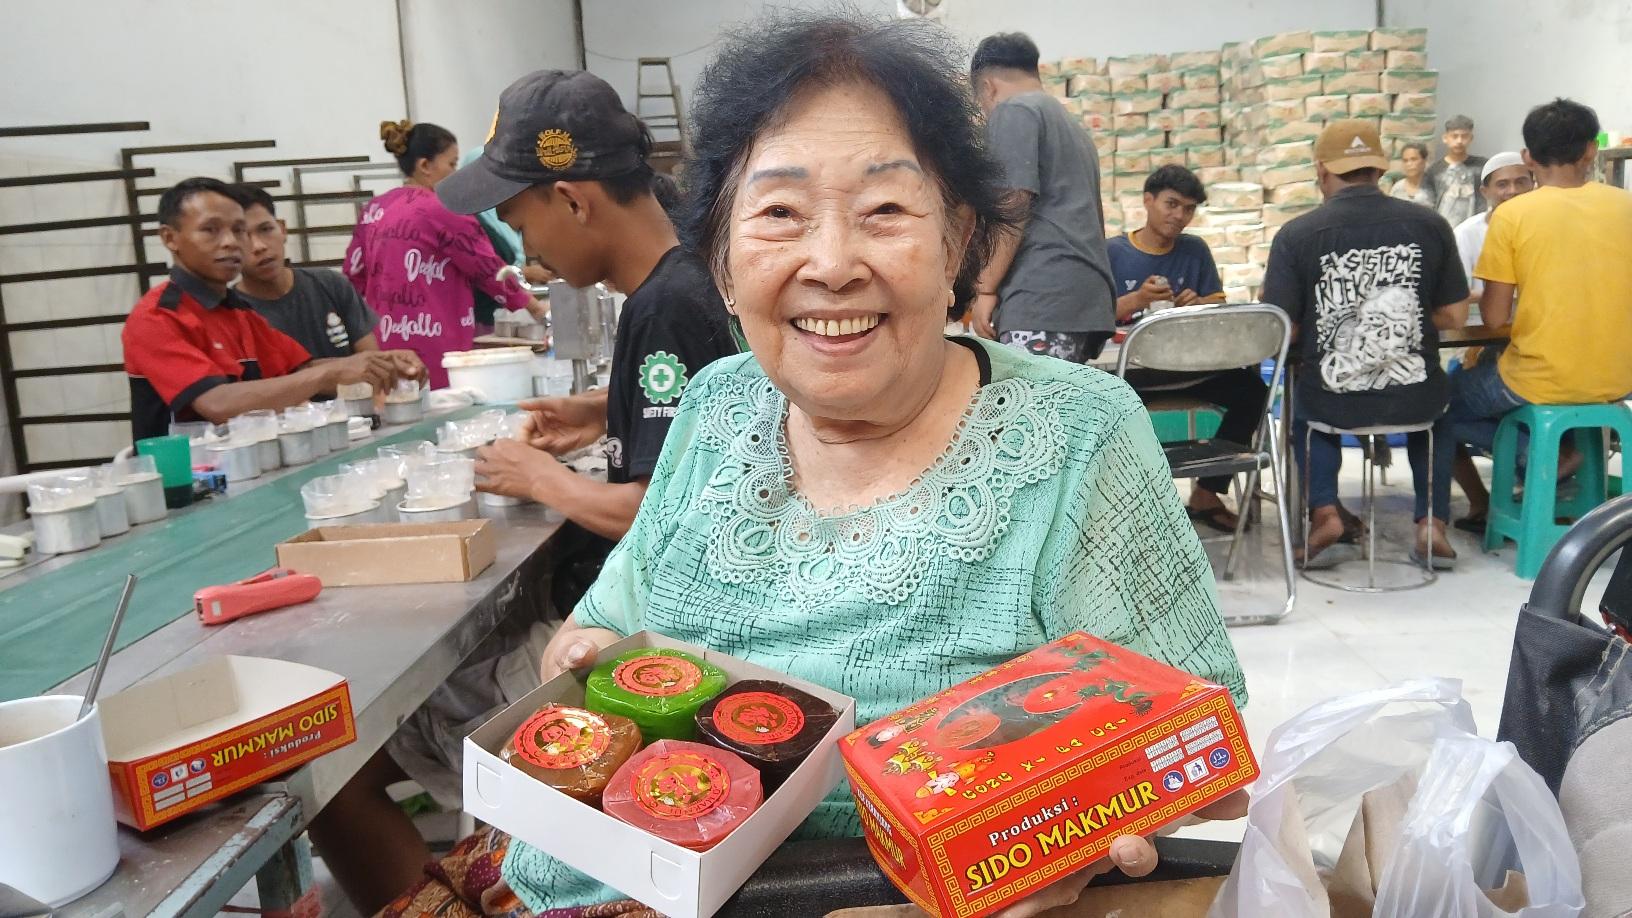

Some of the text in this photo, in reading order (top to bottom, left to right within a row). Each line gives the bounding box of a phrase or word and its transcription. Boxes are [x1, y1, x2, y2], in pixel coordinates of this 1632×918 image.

[211, 704, 338, 767] SIDO MAKMUR
[270, 730, 321, 758] Produksi
[965, 780, 1161, 892] SIDO MAKMUR
[988, 799, 1070, 847] Produksi
